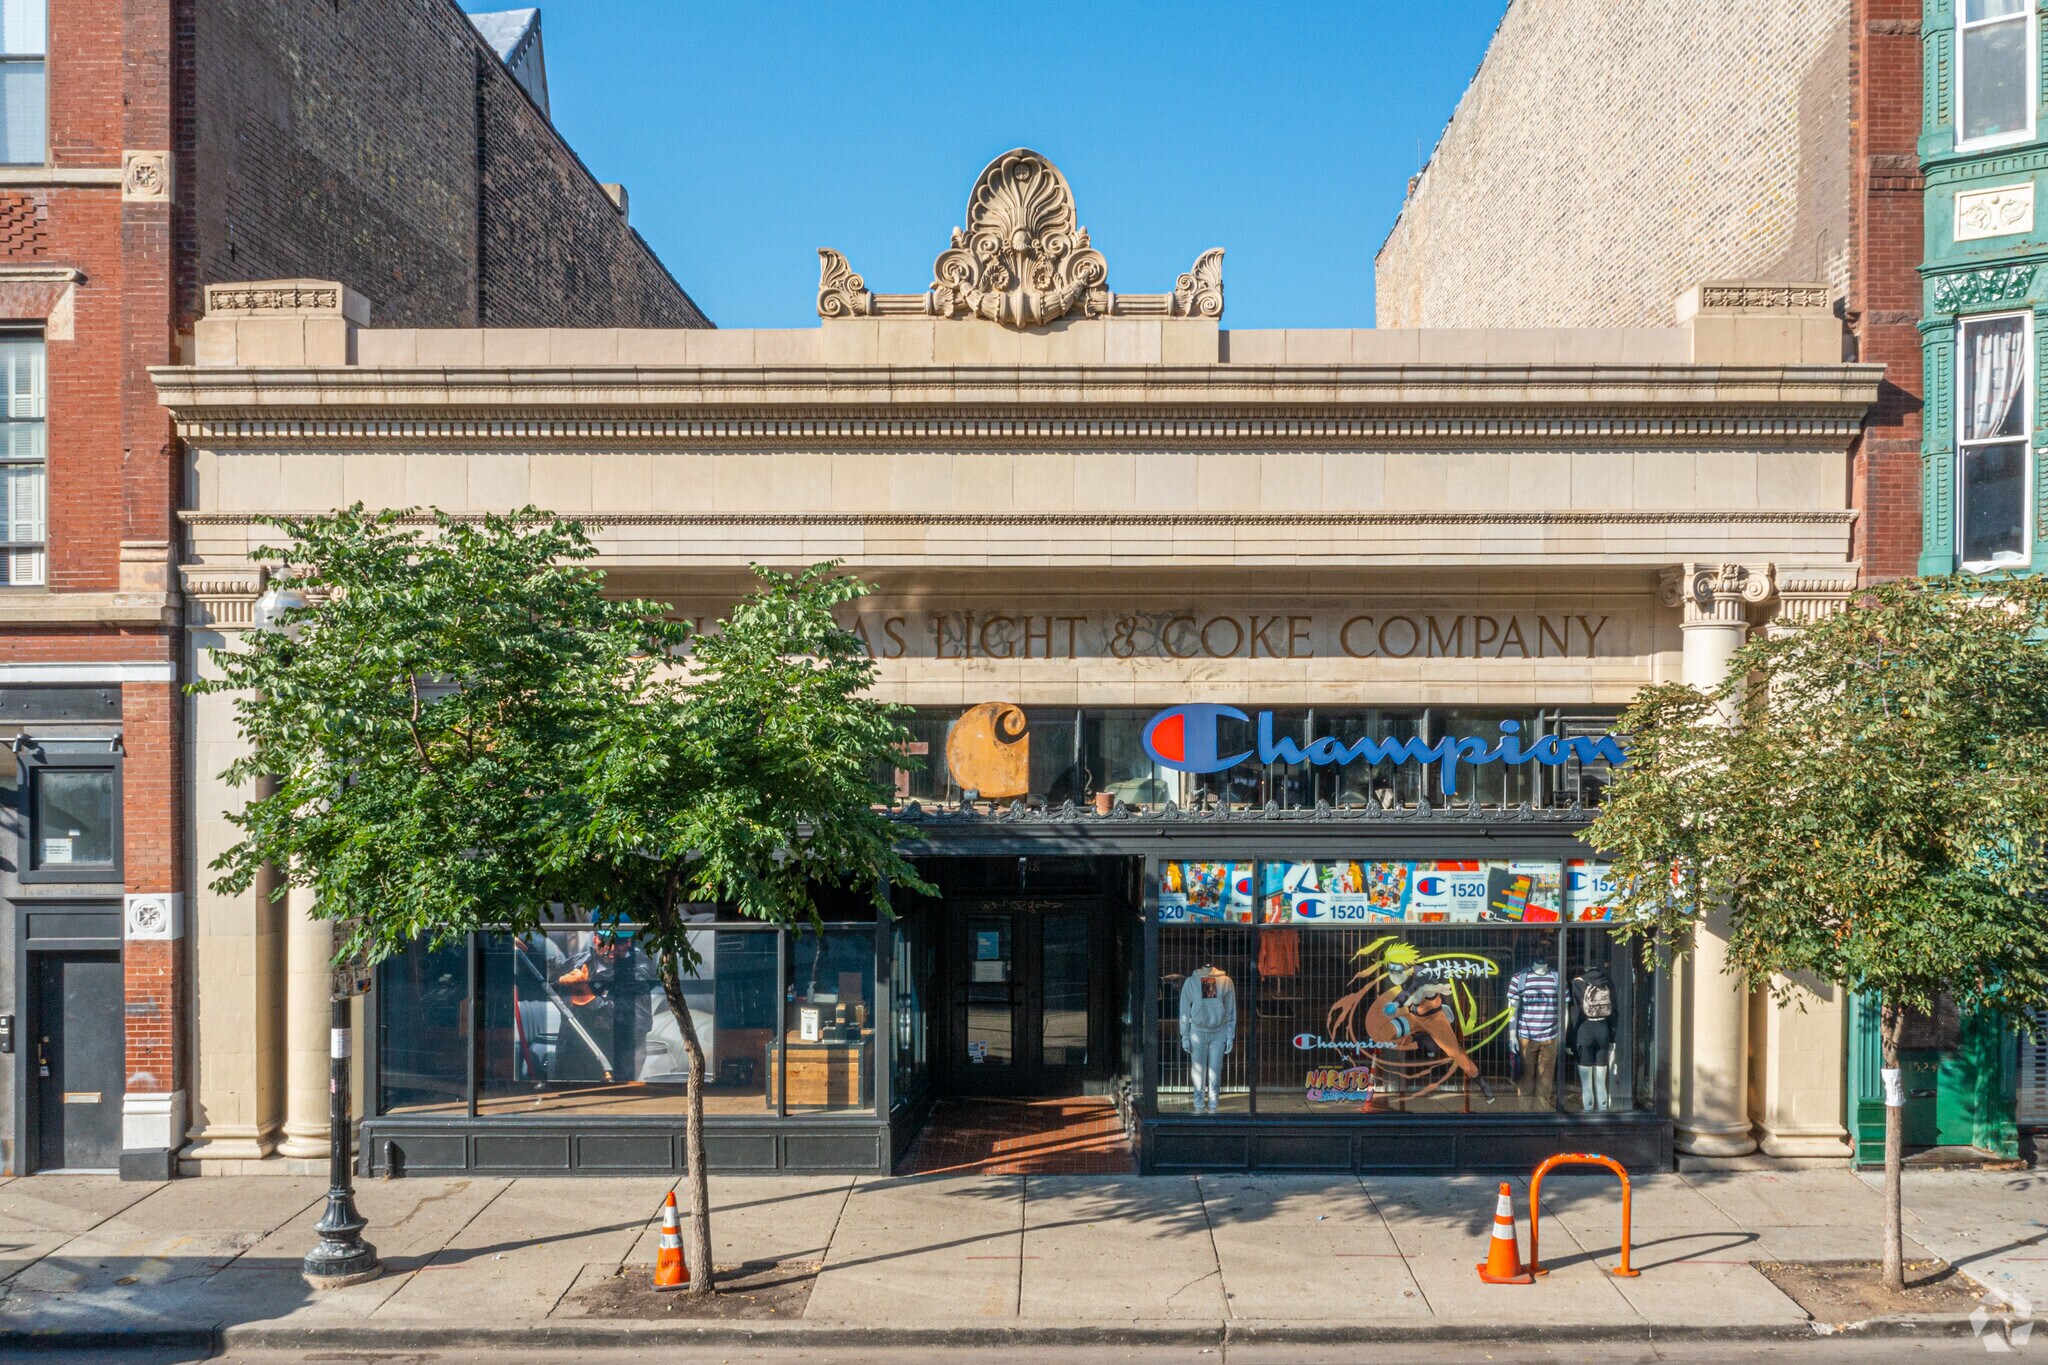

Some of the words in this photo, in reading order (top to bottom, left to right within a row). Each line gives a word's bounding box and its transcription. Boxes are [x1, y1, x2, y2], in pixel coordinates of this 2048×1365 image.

[812, 616, 907, 659] AS
[934, 616, 1088, 659] LIGHT
[1110, 616, 1137, 659] &
[1162, 615, 1314, 659] COKE
[1339, 615, 1609, 659] COMPANY
[1141, 703, 1628, 795] Champion
[1450, 883, 1485, 897] 1520
[1592, 878, 1619, 892] 152
[1330, 905, 1365, 919] 1520
[1292, 1033, 1398, 1055] Champion
[1908, 1062, 1938, 1072] 524
[1305, 1068, 1369, 1090] NARUTO
